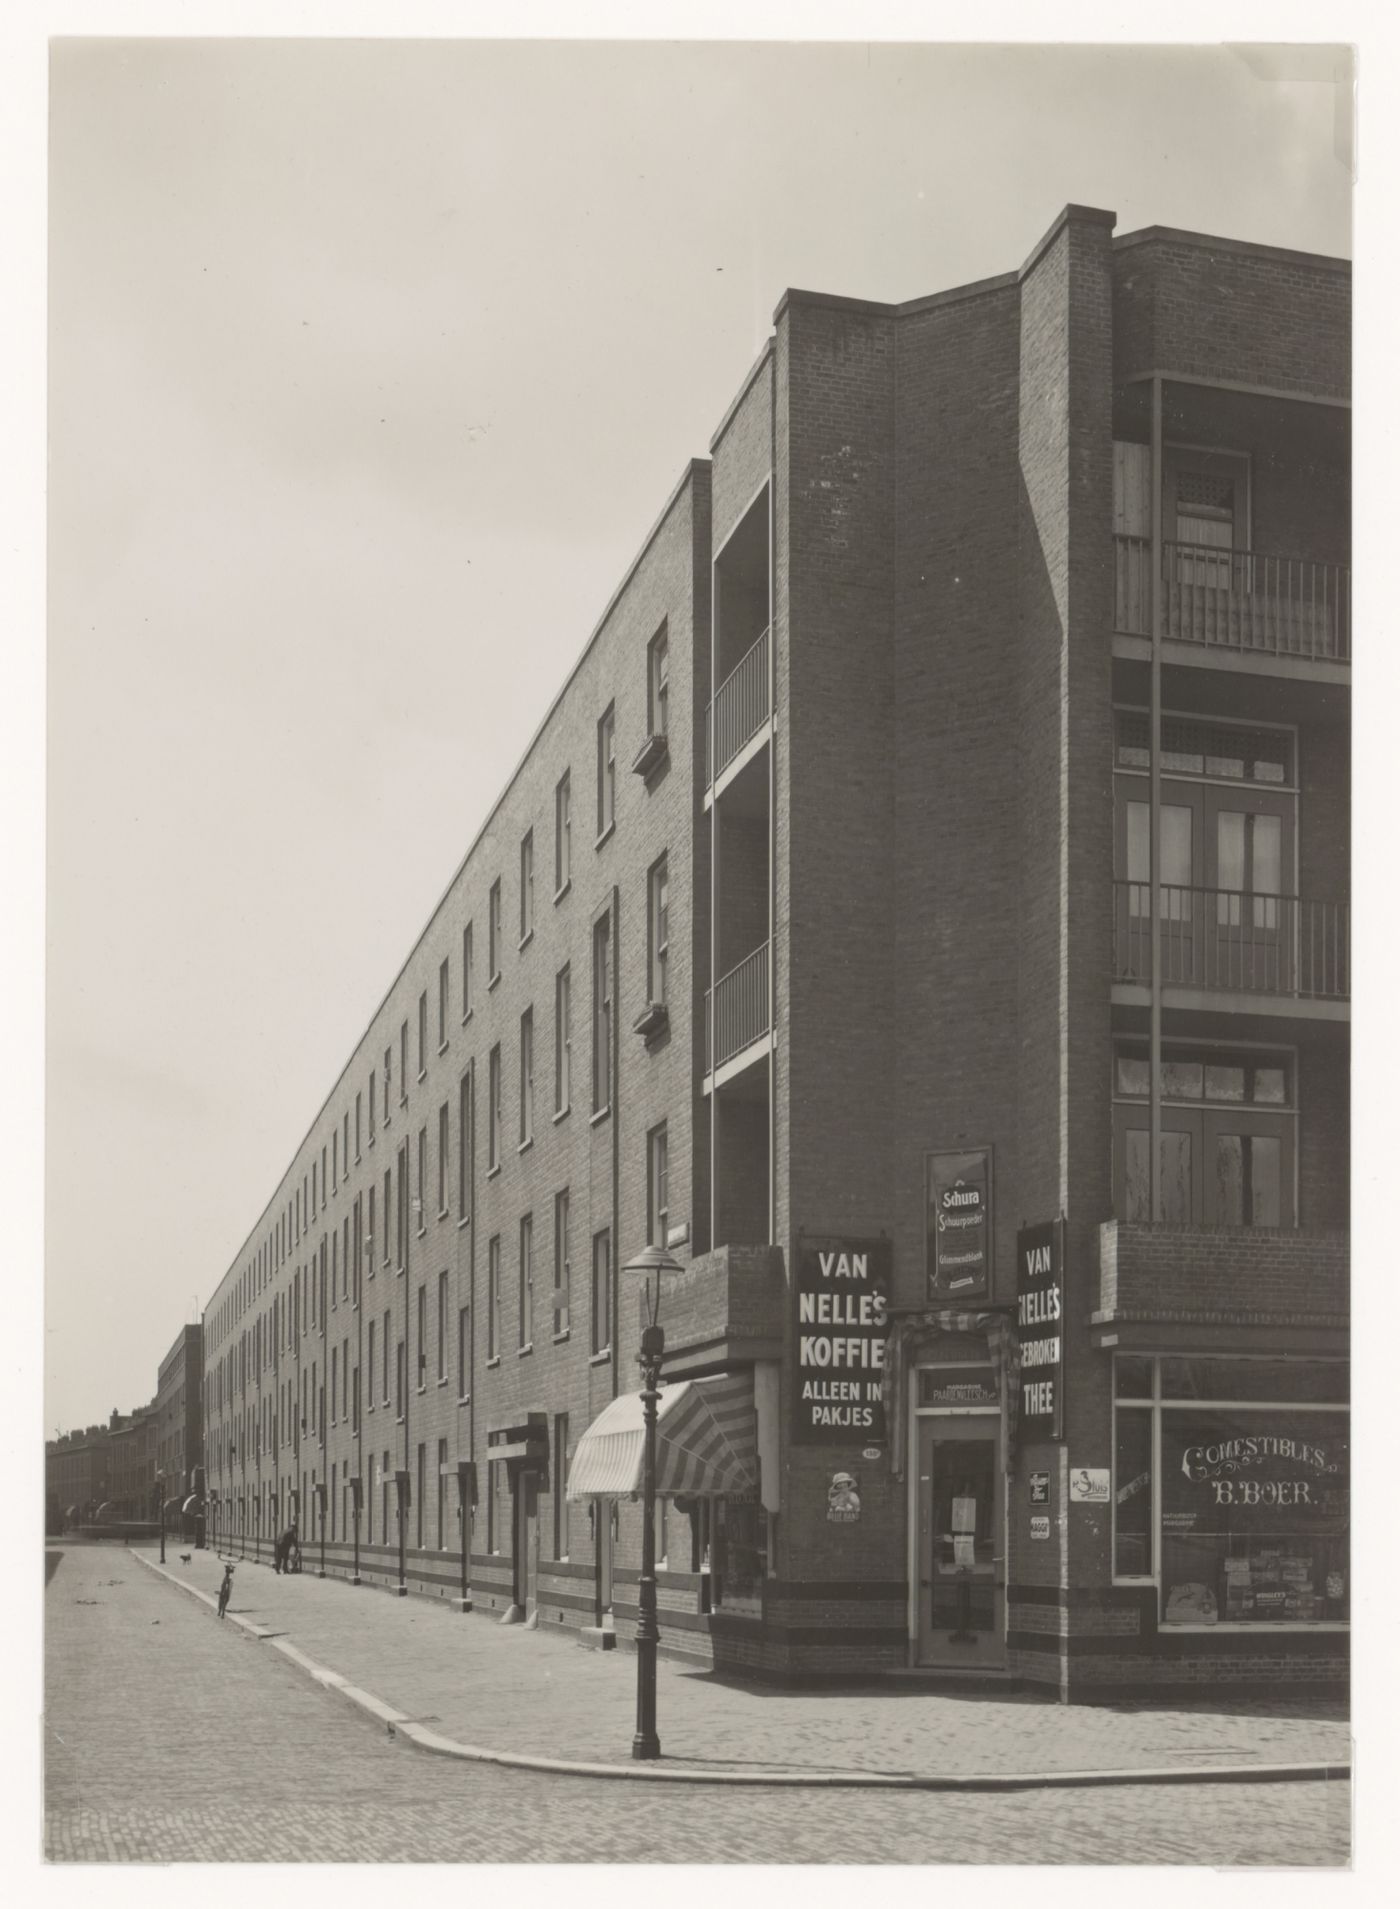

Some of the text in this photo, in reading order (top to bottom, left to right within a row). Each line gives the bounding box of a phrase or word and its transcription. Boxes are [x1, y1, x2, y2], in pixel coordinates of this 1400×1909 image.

[942, 1190, 980, 1208] Schura
[818, 1252, 867, 1279] VAN
[1026, 1245, 1051, 1276] VAN
[799, 1290, 887, 1327] NELLE'S
[800, 1336, 885, 1368] KOFFIE
[802, 1380, 882, 1401] ALLEEN IN
[1023, 1381, 1053, 1416] THEE
[811, 1405, 873, 1427] PAKJES
[1181, 1436, 1326, 1482] COMESTIBLES
